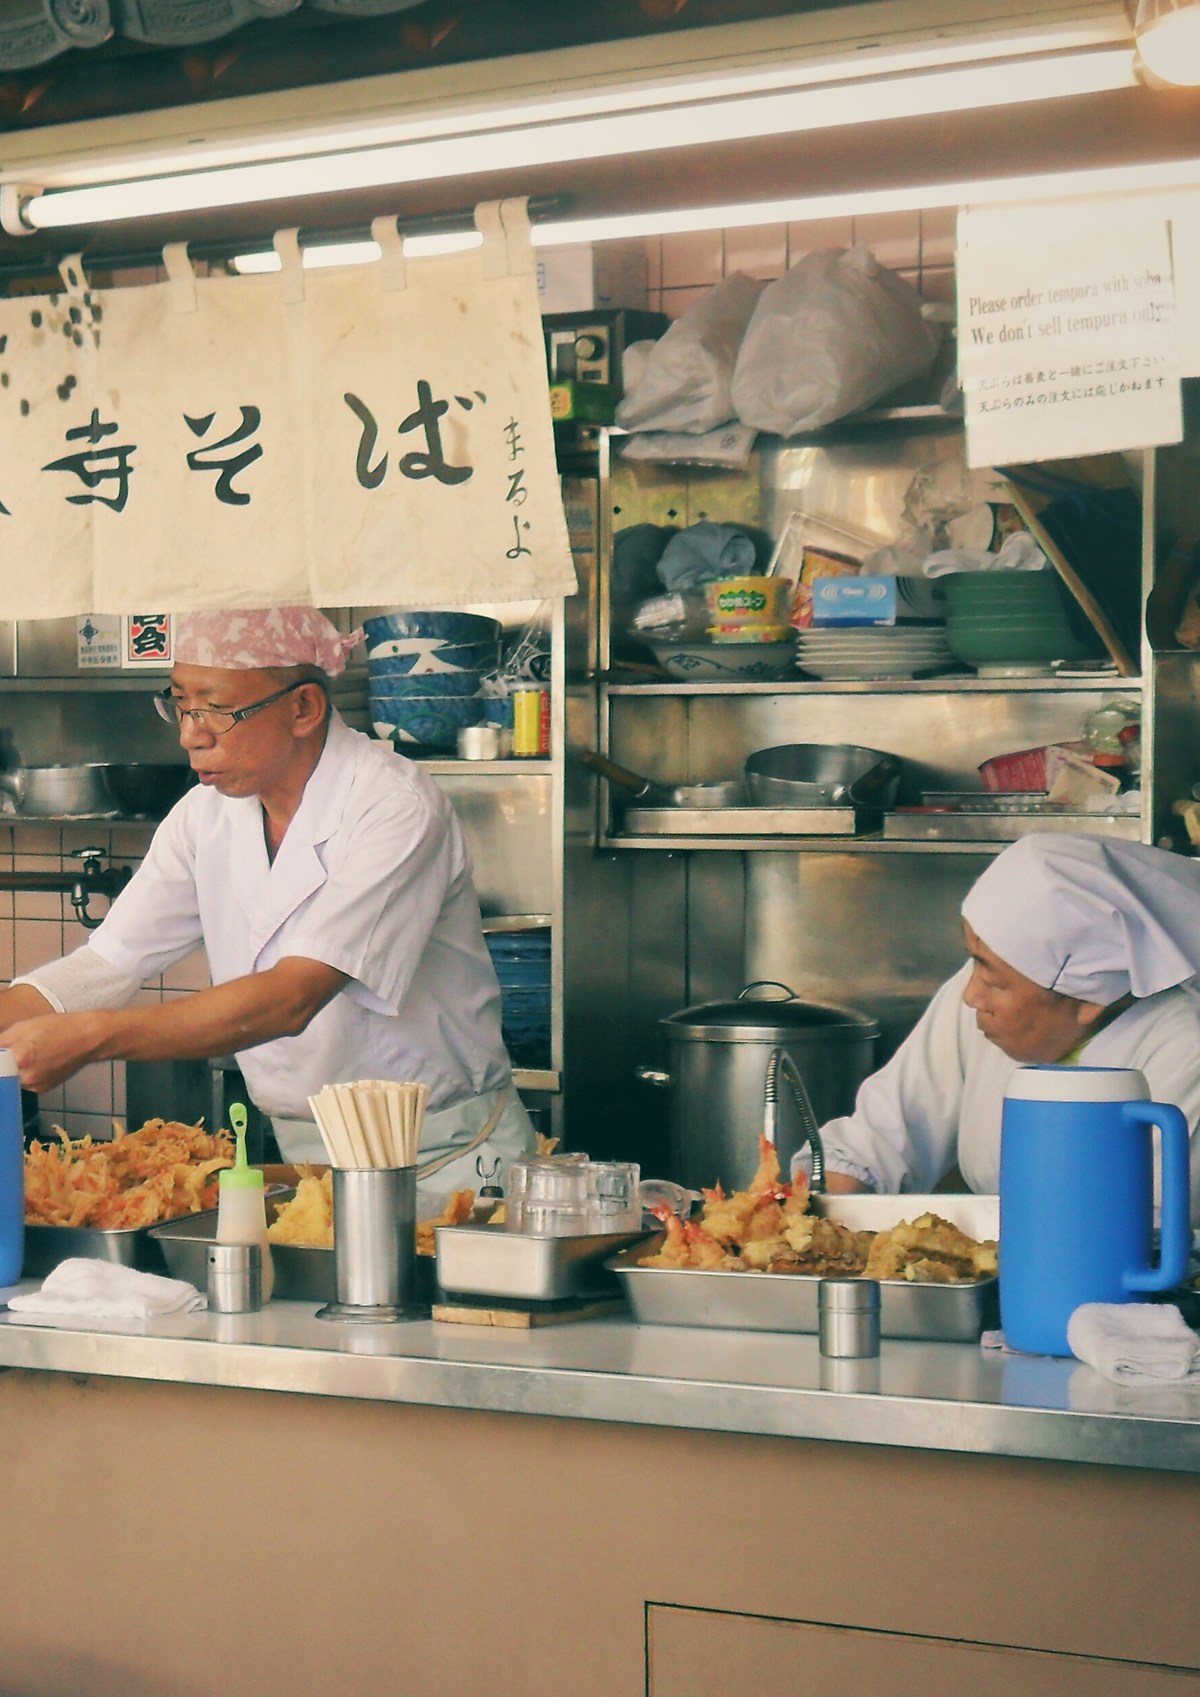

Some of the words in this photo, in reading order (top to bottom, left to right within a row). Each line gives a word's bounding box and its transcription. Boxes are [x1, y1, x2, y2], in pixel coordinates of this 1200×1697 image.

[969, 295, 1007, 316] Please
[1010, 288, 1044, 309] order
[1048, 282, 1098, 306] tempura
[1102, 273, 1130, 294] with
[972, 327, 994, 346] We
[999, 319, 1032, 343] don't
[1038, 315, 1062, 338] sell
[1067, 309, 1128, 335] tempura
[978, 376, 1167, 413] 天ぷらのみの注文には応じかねます
[503, 416, 532, 559] まるよ
